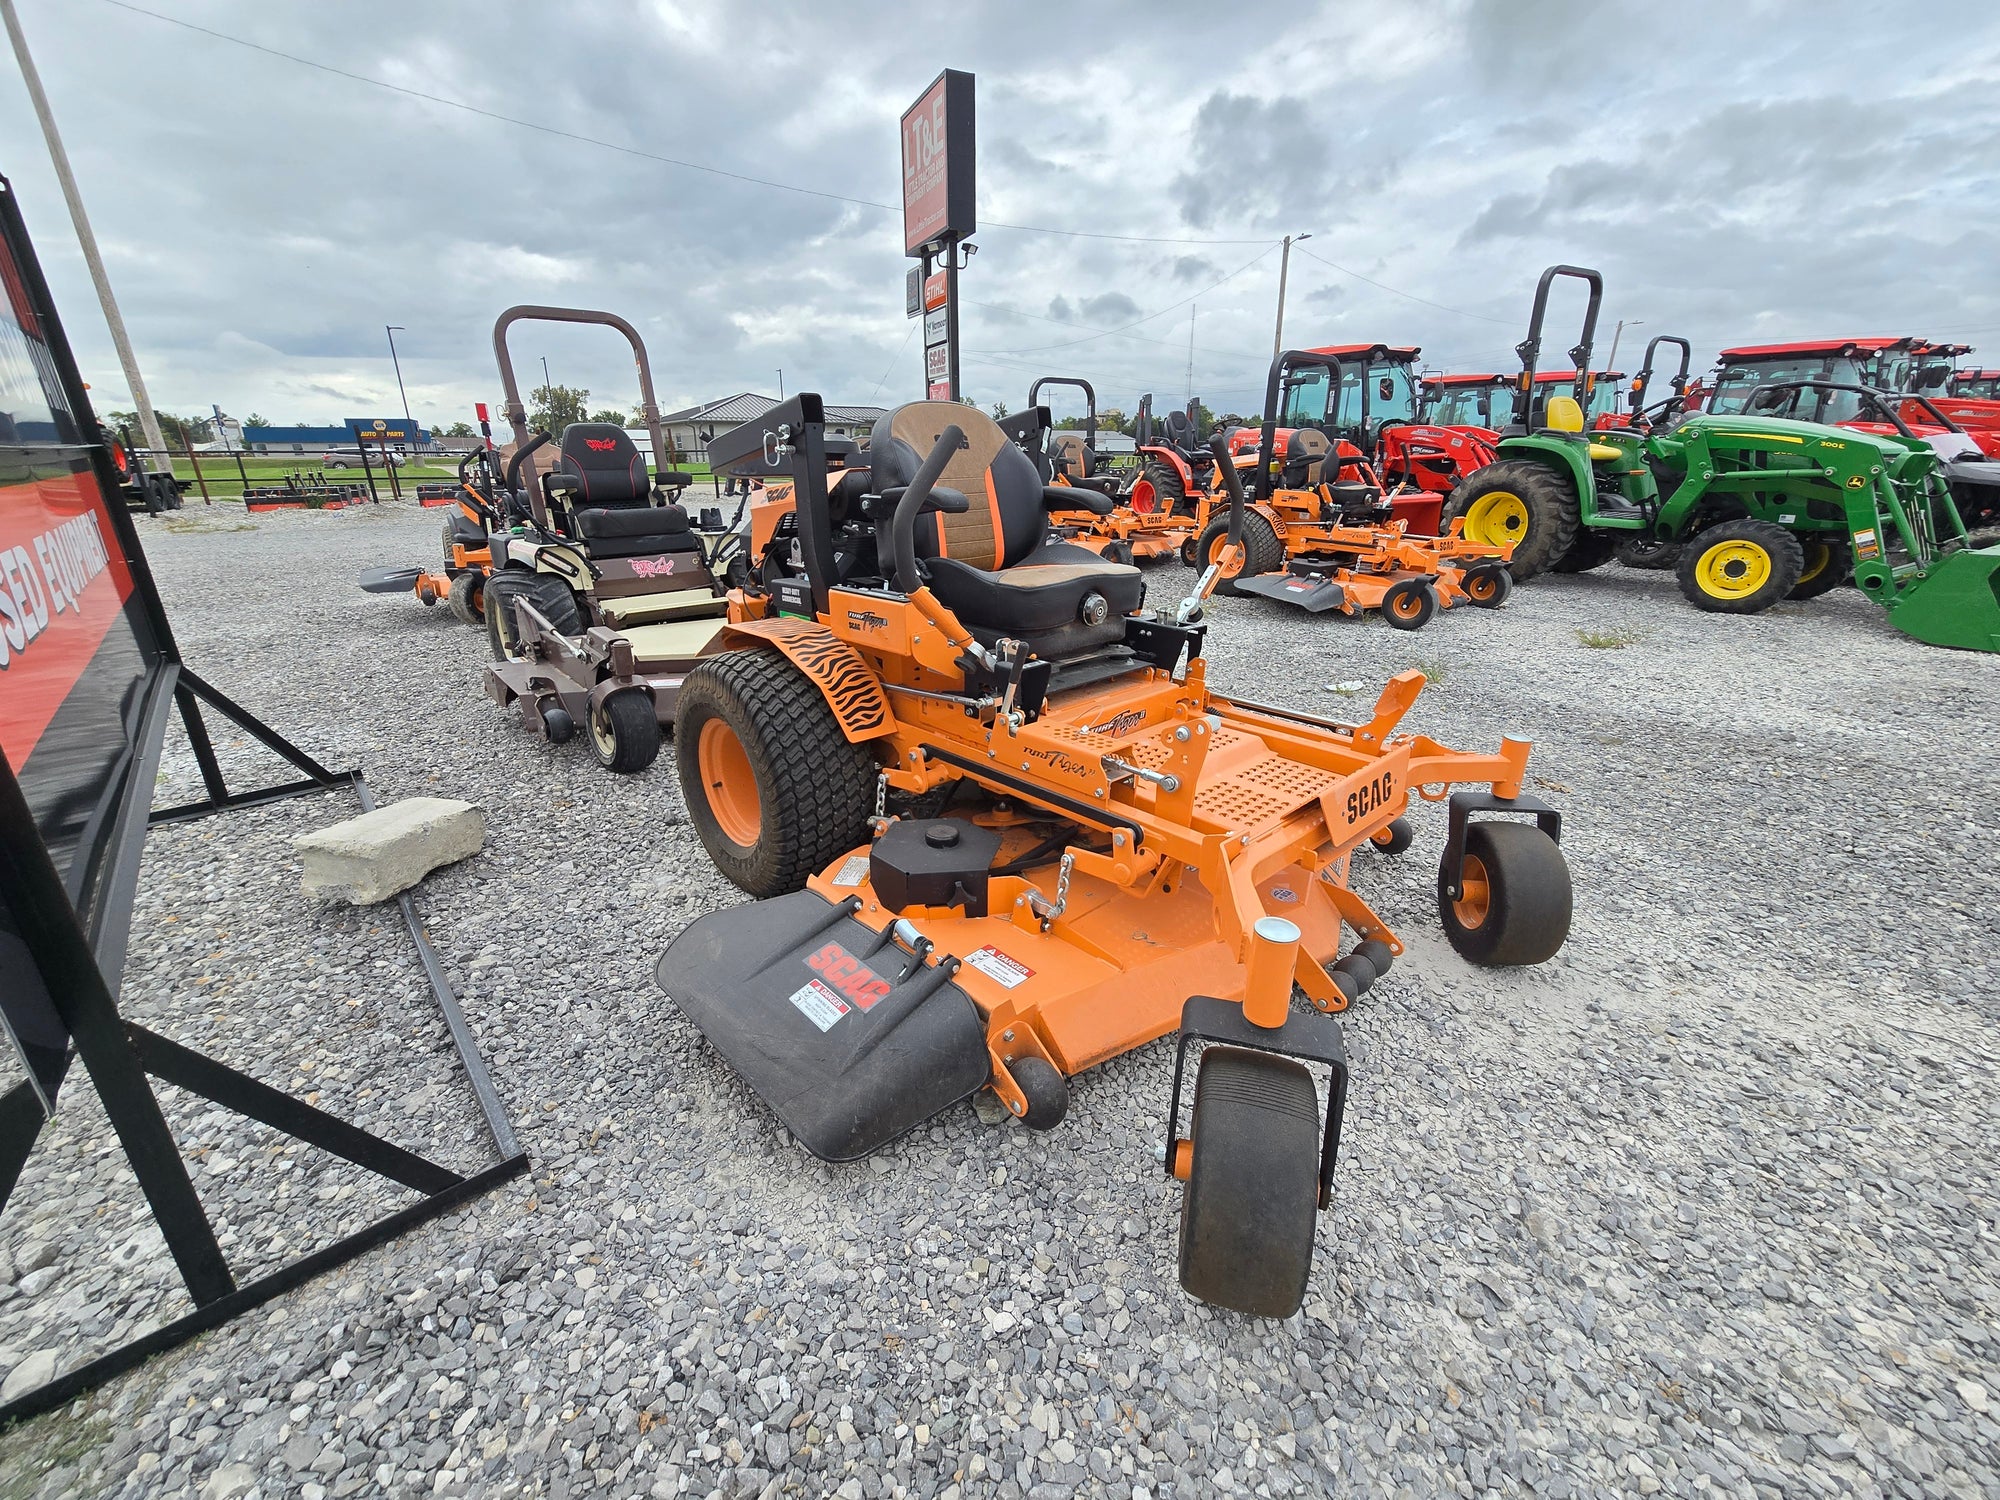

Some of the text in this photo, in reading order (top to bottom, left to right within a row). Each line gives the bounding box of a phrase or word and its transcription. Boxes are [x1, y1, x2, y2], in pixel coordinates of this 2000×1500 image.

[904, 93, 944, 180] LT&E
[926, 280, 945, 303] STIHL
[929, 348, 946, 368] SCAG
[1439, 541, 1454, 551] SCAG
[0, 508, 110, 670] SED EQUIPMENT
[1347, 771, 1392, 825] SCAG
[996, 953, 1029, 975] DANGER
[808, 944, 891, 1009] SCAG
[820, 989, 842, 1009] DANGER
